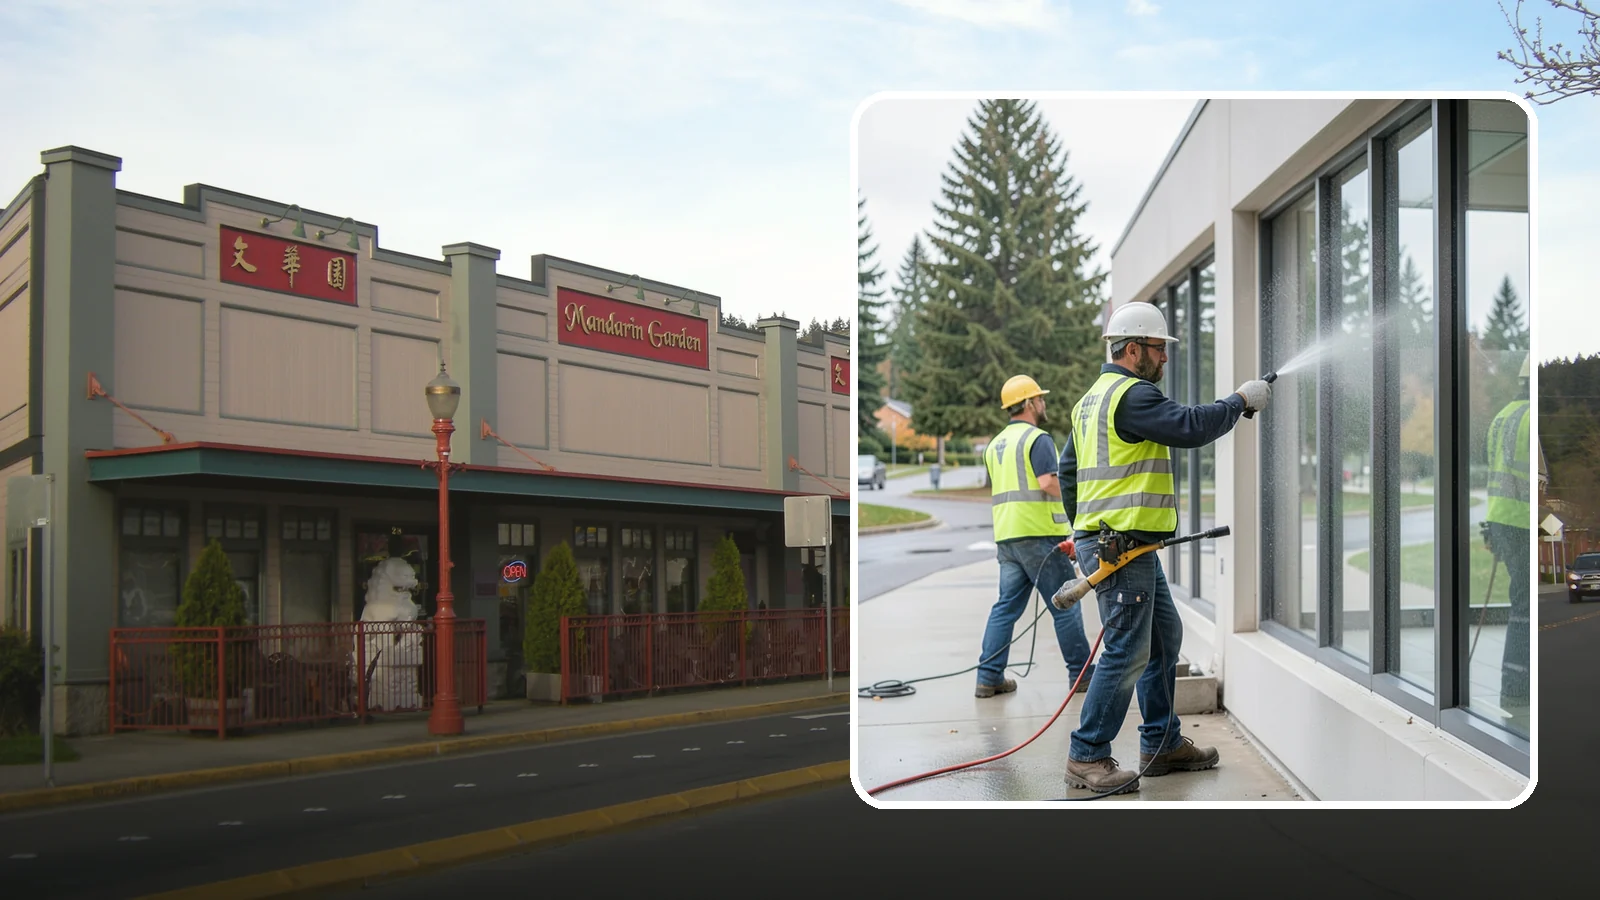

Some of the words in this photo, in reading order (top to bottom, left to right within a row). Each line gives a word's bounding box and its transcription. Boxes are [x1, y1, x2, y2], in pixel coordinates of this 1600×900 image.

[231, 235, 346, 290] 文華園
[564, 302, 644, 341] Mandarin
[648, 320, 701, 352] Garden
[503, 565, 527, 578] OPEN
